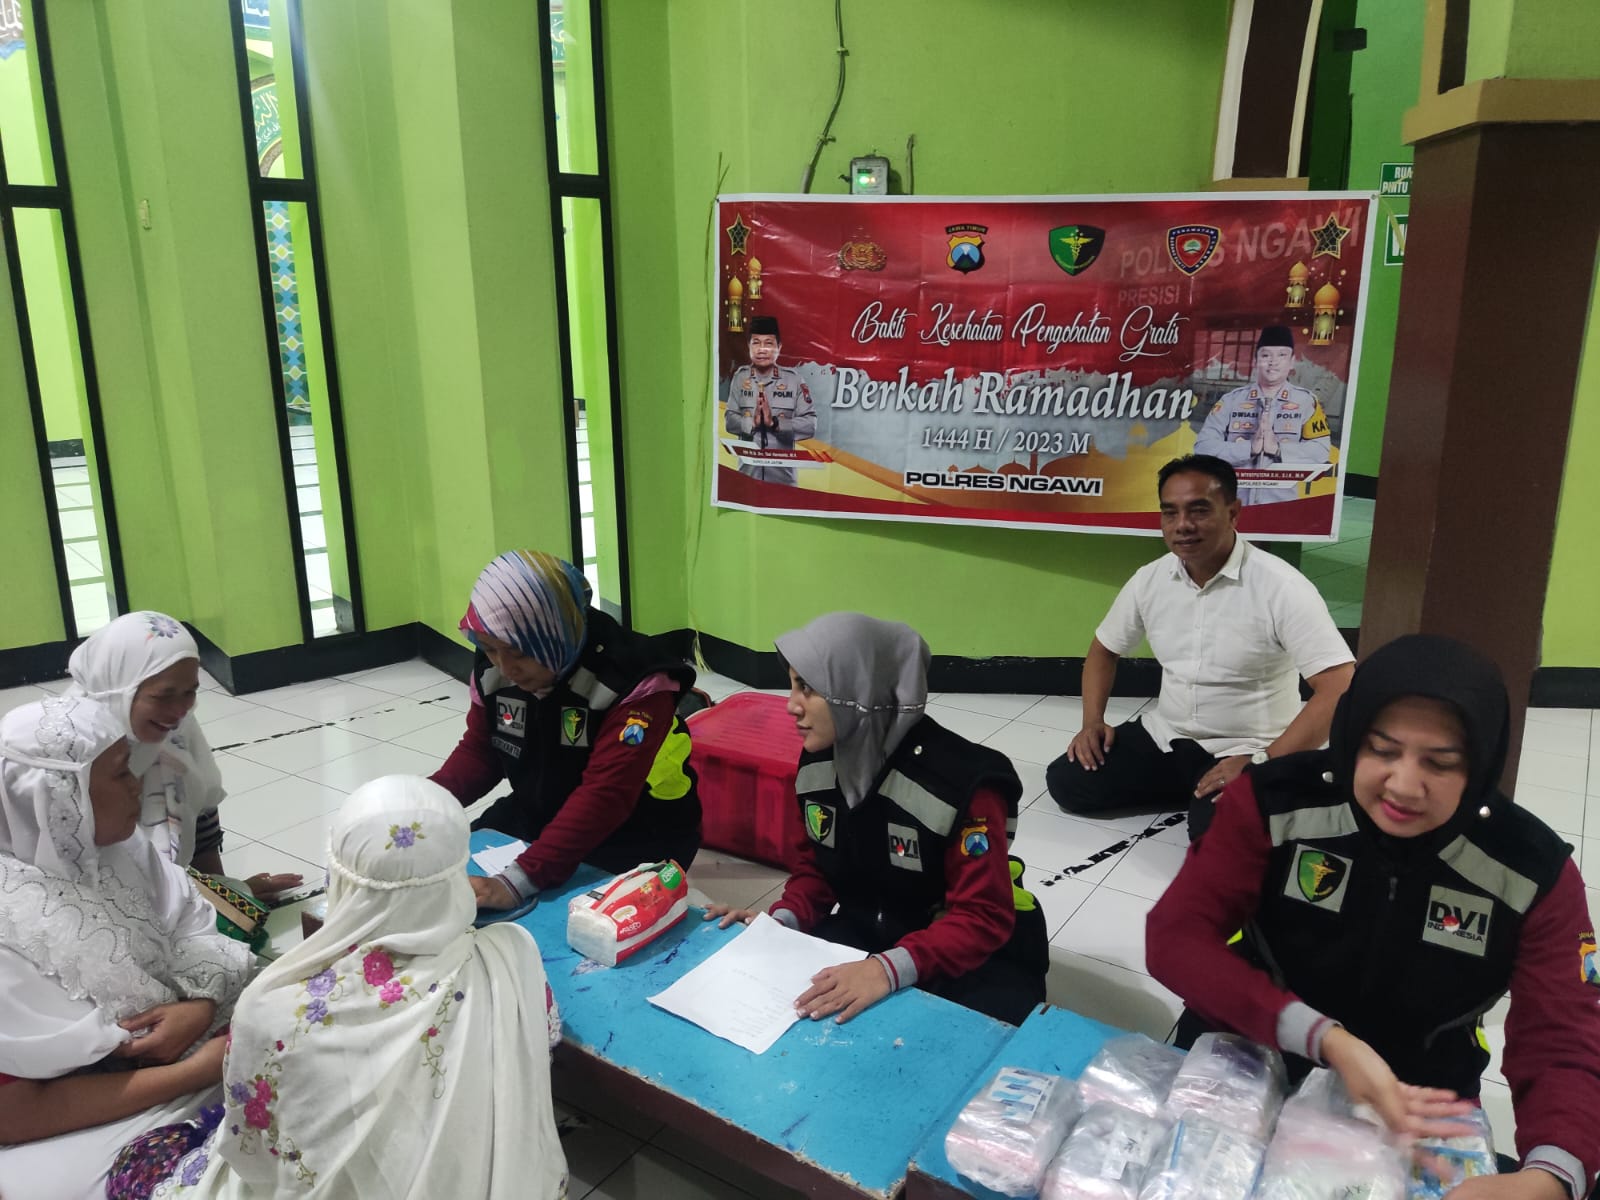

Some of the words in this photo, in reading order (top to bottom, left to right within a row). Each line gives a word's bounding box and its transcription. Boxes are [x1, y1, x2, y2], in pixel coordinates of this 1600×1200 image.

[1394, 166, 1413, 179] RUA
[1118, 284, 1181, 307] PRESISI
[851, 300, 918, 344] Bakti
[919, 302, 1004, 347] Kesehatan
[1011, 302, 1112, 354] Pengobatan
[1119, 305, 1190, 362] Gratis
[831, 366, 964, 413] Berkah
[973, 371, 1194, 420] Ramadhan
[921, 428, 969, 450] 1444
[974, 429, 994, 450] H
[1013, 431, 1063, 454] 2023
[1067, 432, 1091, 454] M
[906, 471, 1005, 490] POLRES
[1010, 476, 1100, 494] NGAWI
[498, 702, 526, 722] DVI
[890, 835, 919, 855] DVI
[1429, 900, 1488, 935] DVI
